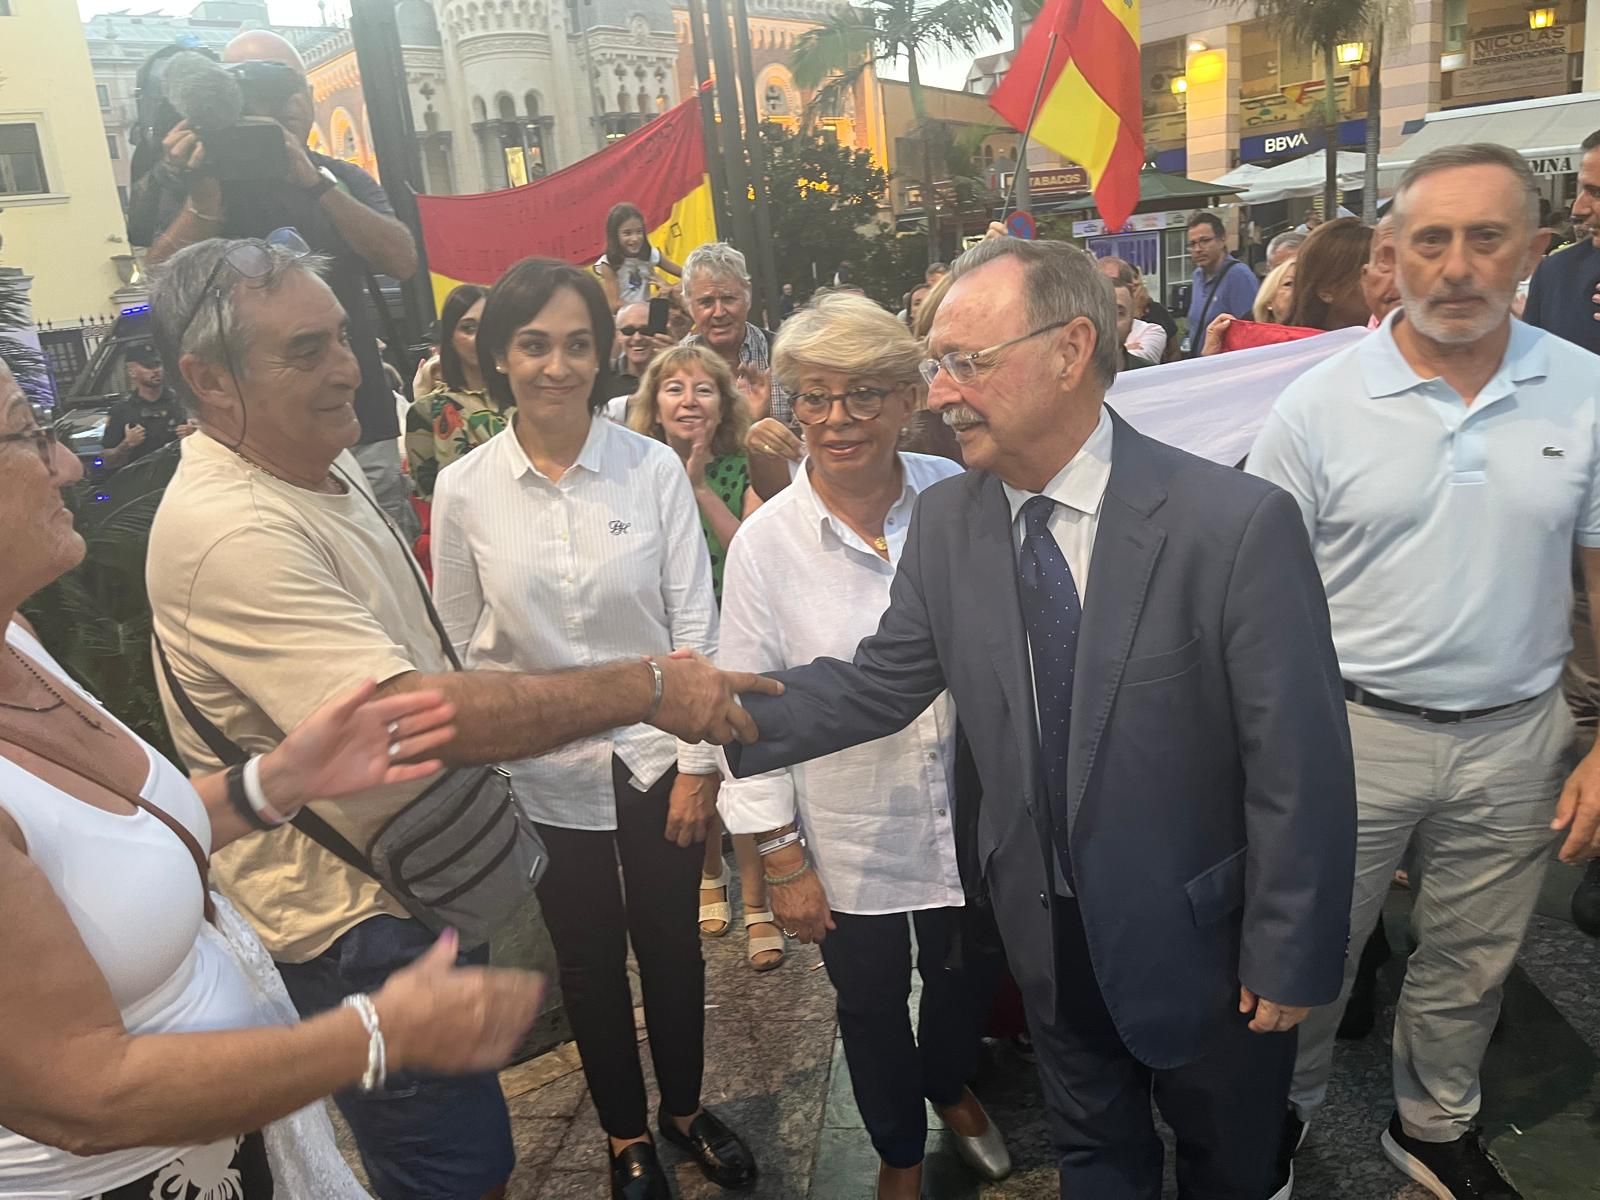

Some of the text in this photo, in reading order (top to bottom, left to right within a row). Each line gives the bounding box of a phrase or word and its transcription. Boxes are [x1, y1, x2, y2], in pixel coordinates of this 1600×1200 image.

[1473, 25, 1565, 52] NICOLAS
[1264, 132, 1309, 153] BBVA
[1029, 173, 1081, 187] TABACOS
